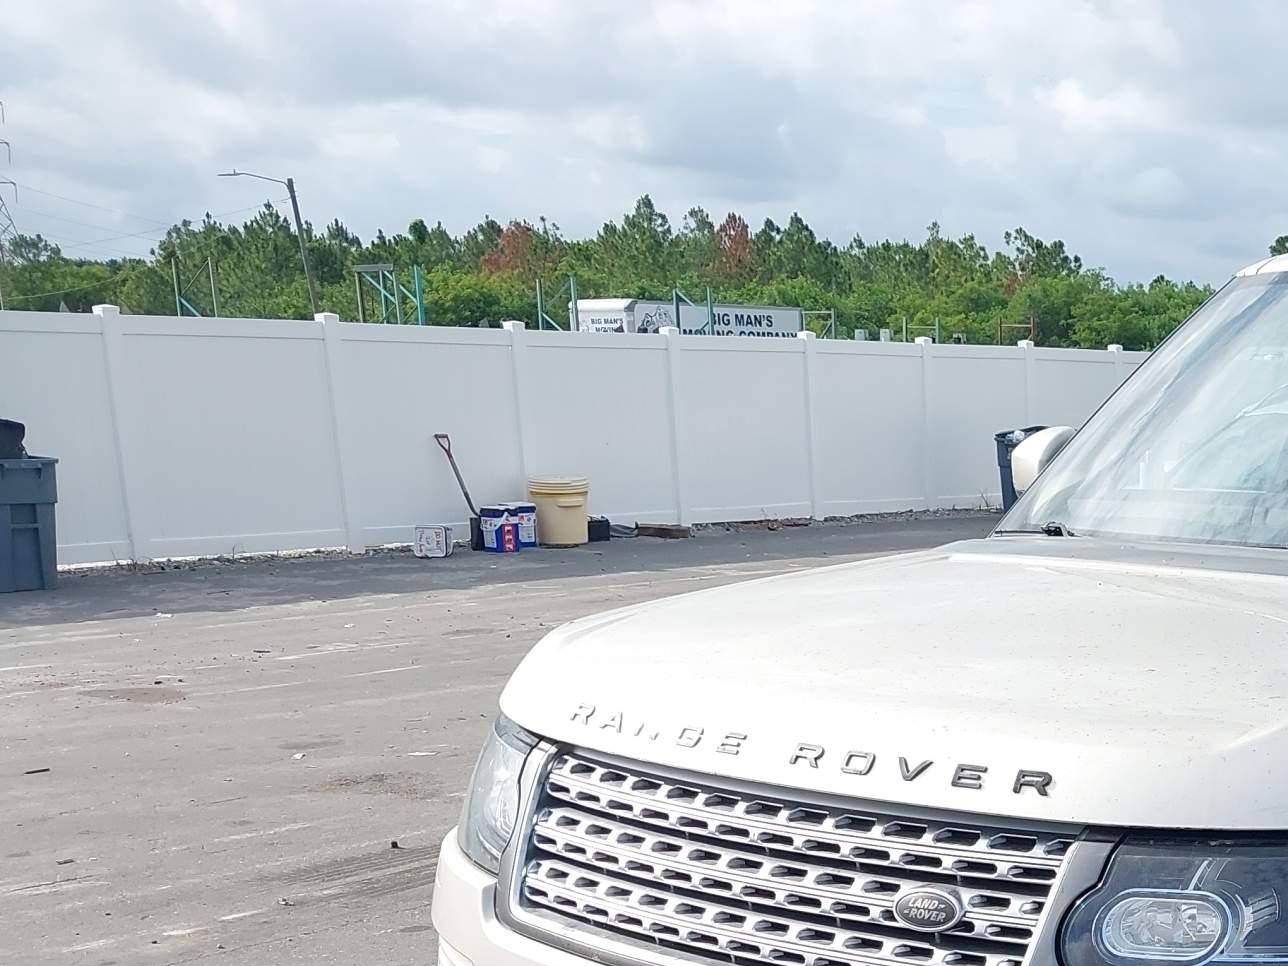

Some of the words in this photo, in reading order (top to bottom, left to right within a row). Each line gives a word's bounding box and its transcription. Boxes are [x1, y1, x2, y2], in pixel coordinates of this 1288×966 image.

[735, 313, 774, 328] MAN'S
[788, 742, 1057, 799] ROVER
[908, 896, 938, 910] LAND
[908, 908, 946, 922] ROVER
